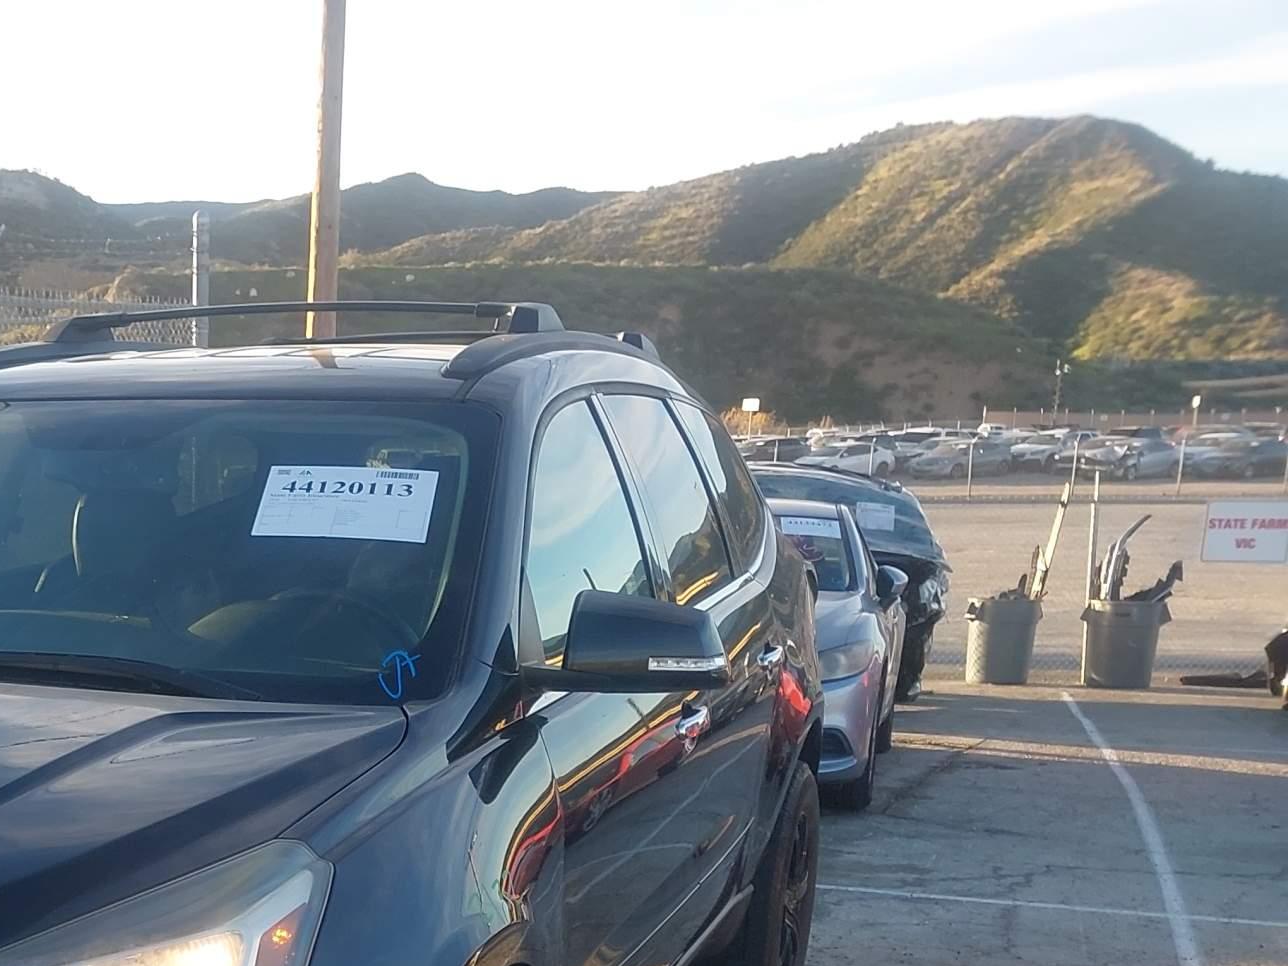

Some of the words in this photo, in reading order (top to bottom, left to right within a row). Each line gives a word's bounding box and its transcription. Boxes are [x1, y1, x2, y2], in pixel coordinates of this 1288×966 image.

[281, 480, 414, 497] 44120113
[1208, 518, 1248, 529] STATE
[1235, 538, 1257, 549] VIC
